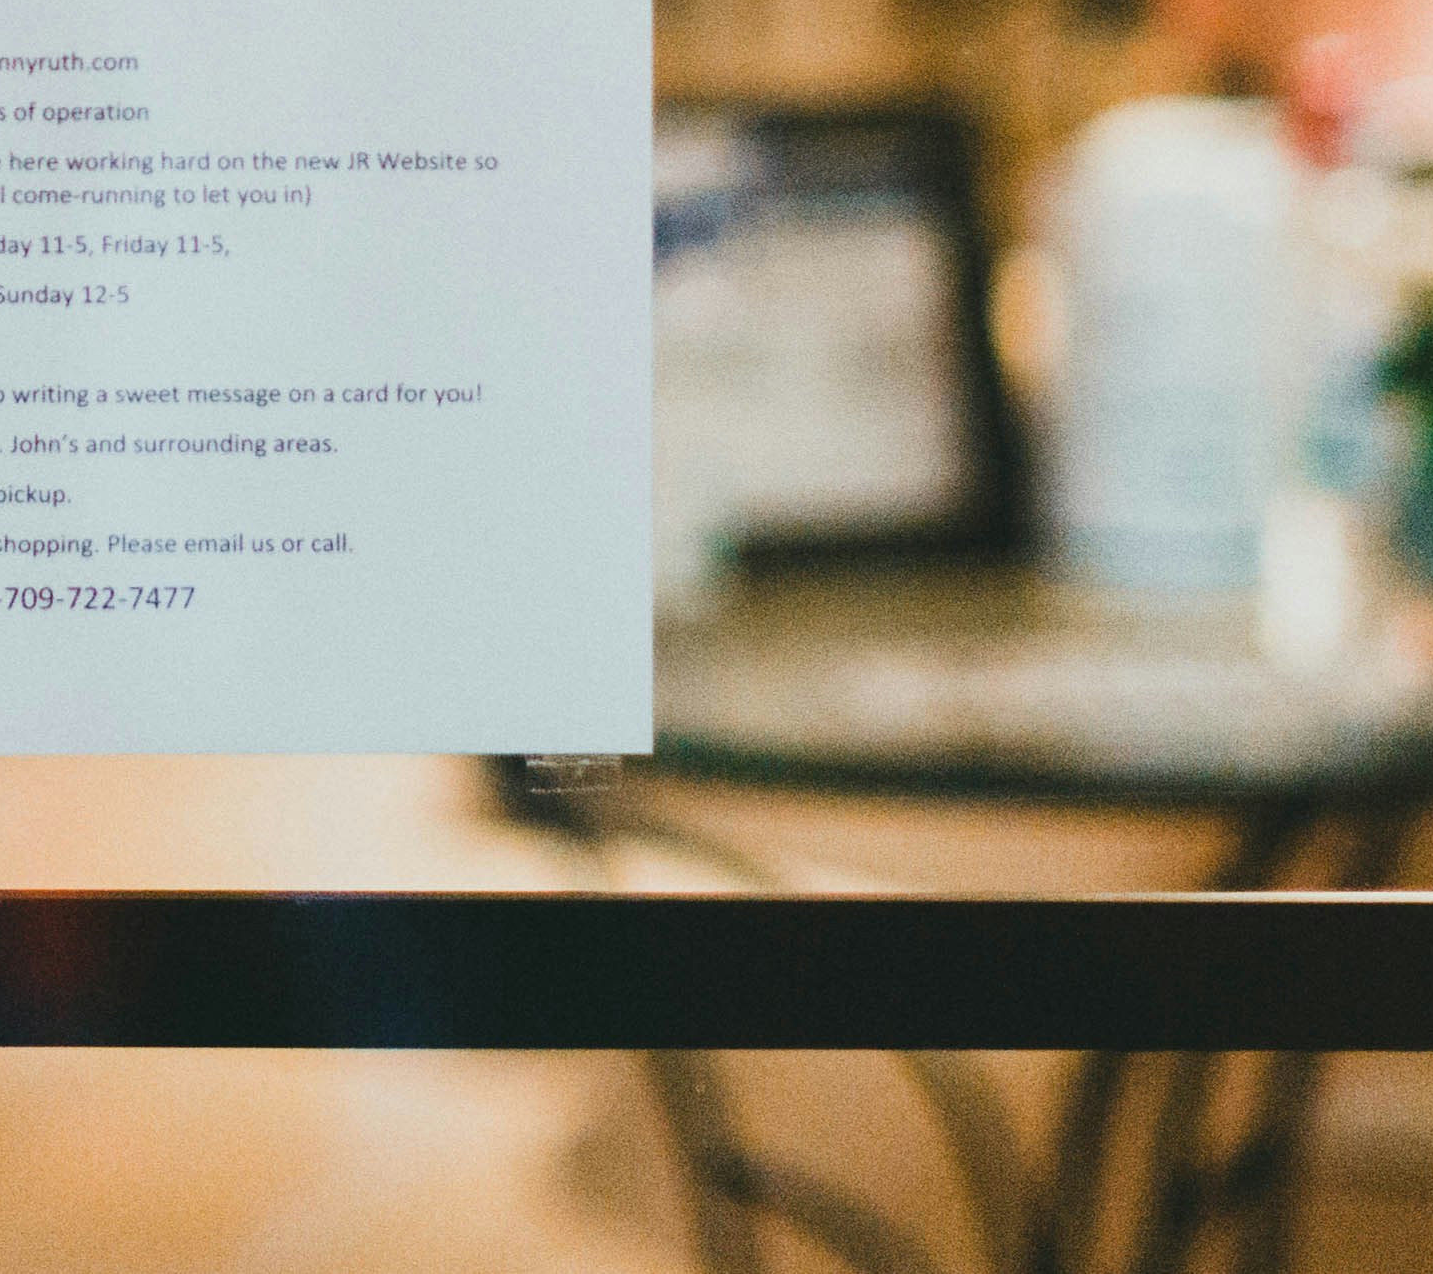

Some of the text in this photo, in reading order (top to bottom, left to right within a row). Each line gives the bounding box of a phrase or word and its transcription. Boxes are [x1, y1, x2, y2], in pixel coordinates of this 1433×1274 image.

[13, 101, 36, 123] of
[41, 104, 150, 126] operation
[8, 152, 59, 173] here
[65, 152, 155, 176] working
[160, 151, 211, 171] hard
[217, 155, 245, 172] on
[251, 151, 288, 172] the
[294, 155, 341, 171] new
[347, 151, 371, 171] JR
[376, 151, 468, 172] Website
[474, 155, 499, 171] so
[11, 188, 167, 210] come-running
[172, 187, 197, 205] to
[202, 184, 230, 205] let
[236, 188, 277, 209] you
[283, 184, 312, 208] in)
[40, 234, 93, 257] 11-5,
[101, 234, 169, 258] Friday
[177, 234, 230, 257] 11-5,
[82, 284, 131, 306] 12-5
[11, 384, 90, 409] writing
[95, 389, 108, 404] a
[115, 386, 180, 404] sweet
[187, 387, 282, 409] message
[288, 387, 316, 404] on
[322, 388, 336, 404] a
[341, 383, 389, 404] card
[395, 383, 428, 404] for
[433, 384, 482, 407] you!
[85, 434, 127, 455] and
[133, 433, 268, 459] surrounding
[273, 437, 339, 454] areas.
[107, 533, 178, 554] Please
[183, 533, 245, 554] email
[251, 537, 276, 554] us
[280, 537, 305, 554] or
[310, 532, 354, 554] call.
